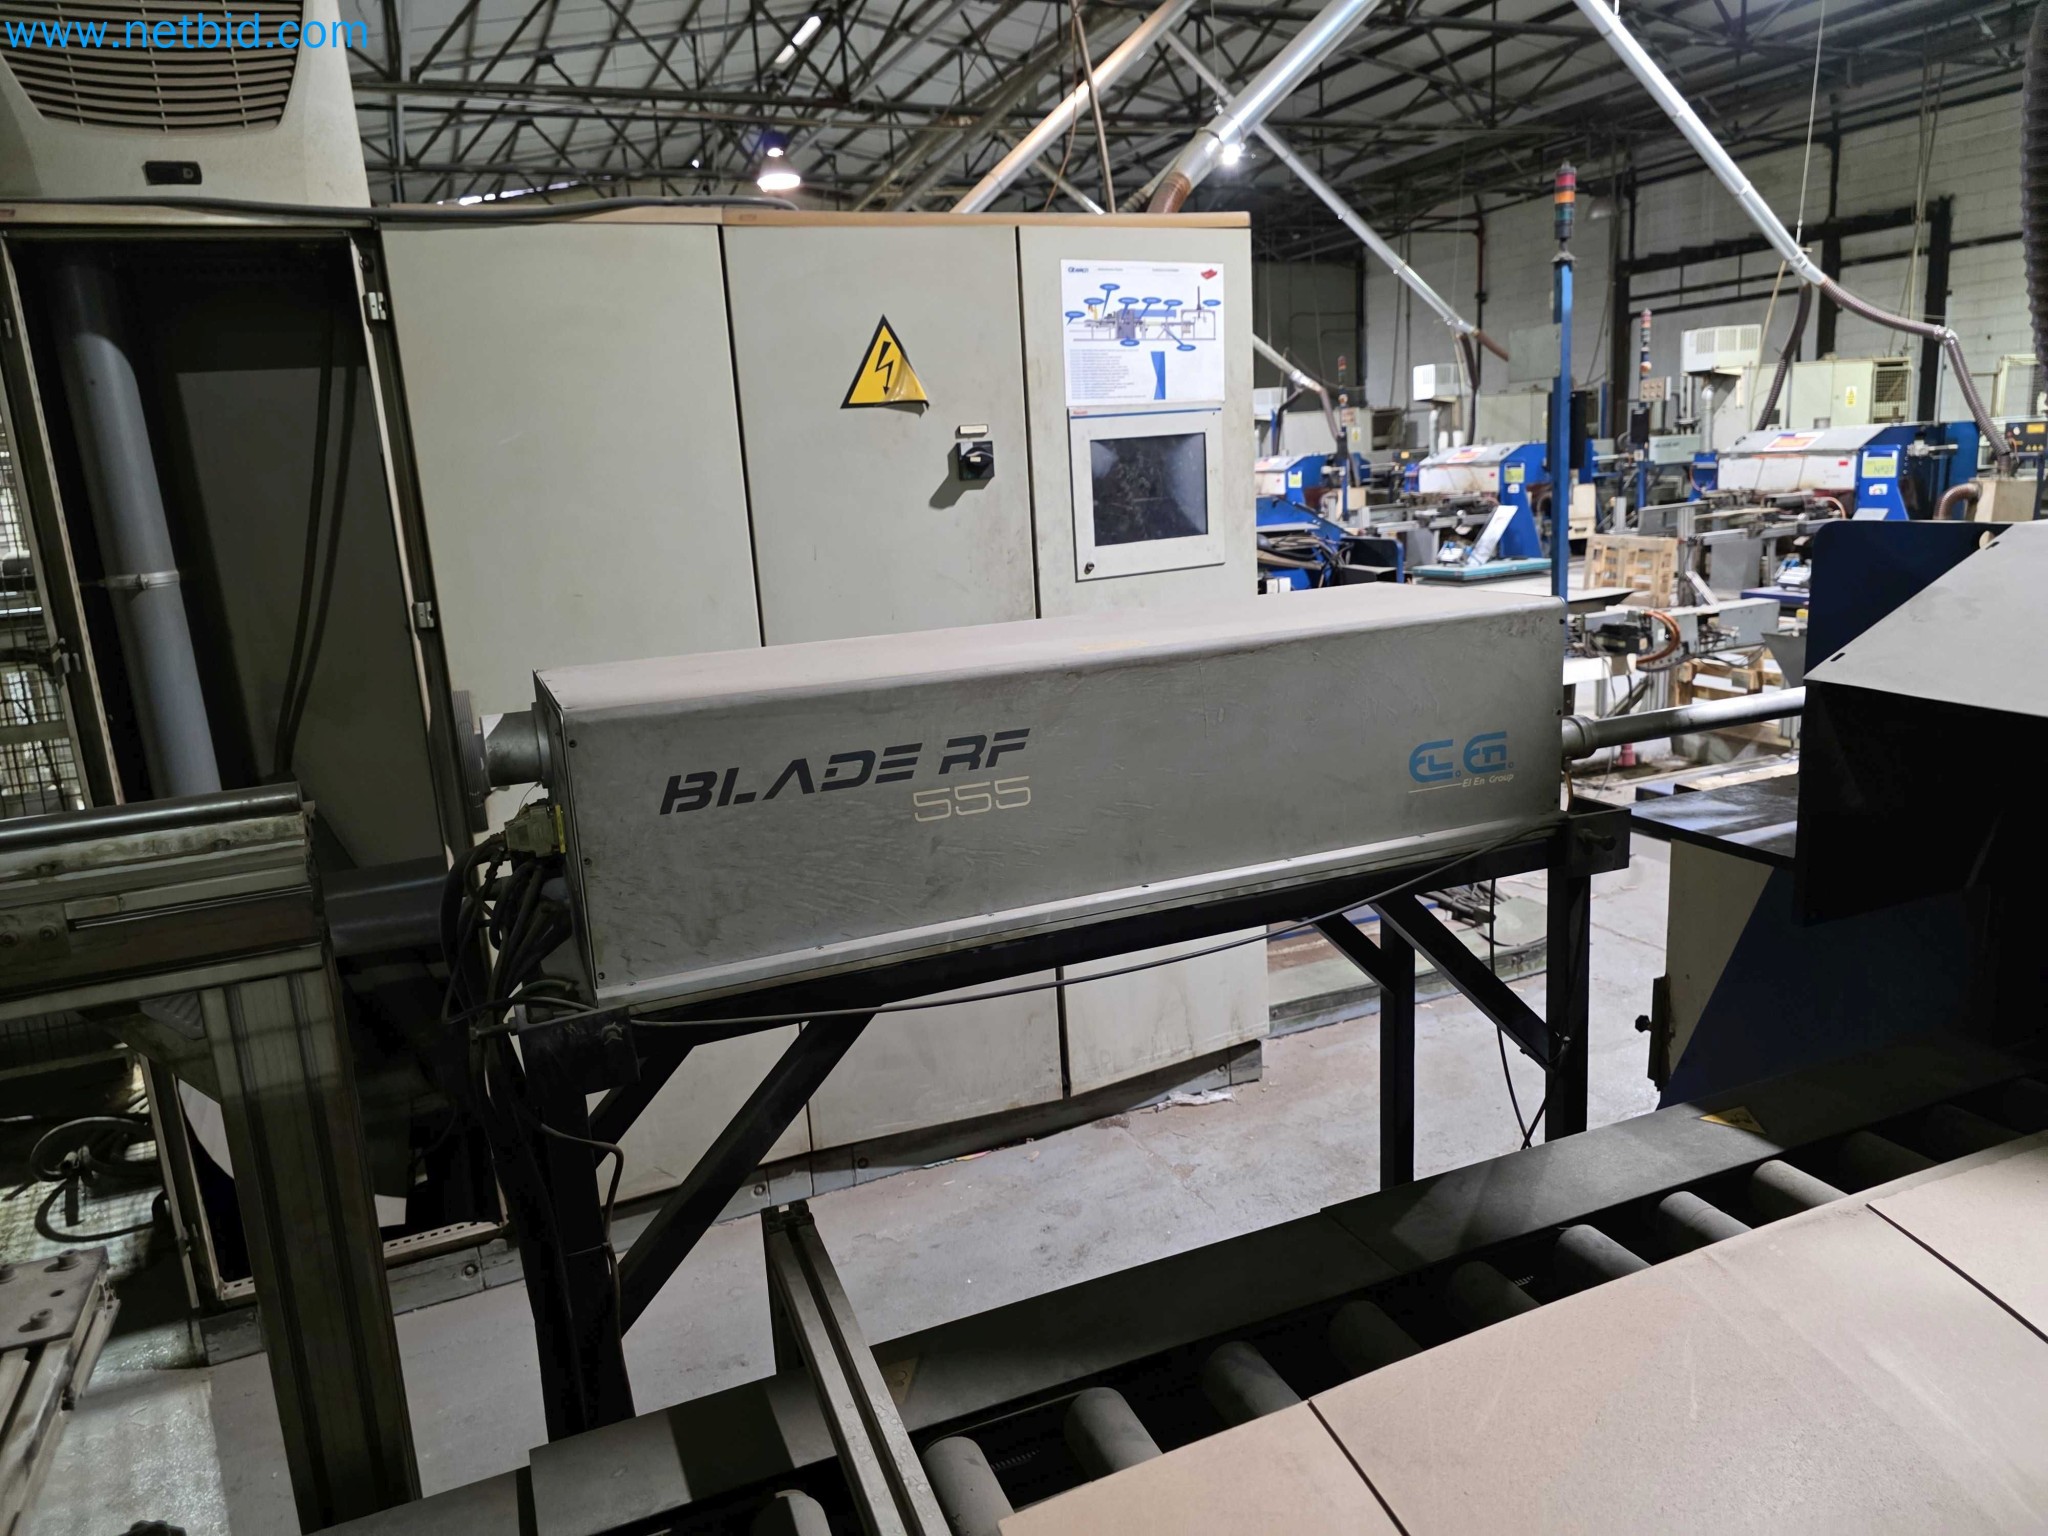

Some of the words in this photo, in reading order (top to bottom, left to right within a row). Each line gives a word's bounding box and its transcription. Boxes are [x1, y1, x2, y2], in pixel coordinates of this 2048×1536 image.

[659, 742, 924, 815] BLADE
[938, 727, 1031, 775] RF
[1488, 773, 1515, 784] Group
[912, 775, 1032, 823] 555
